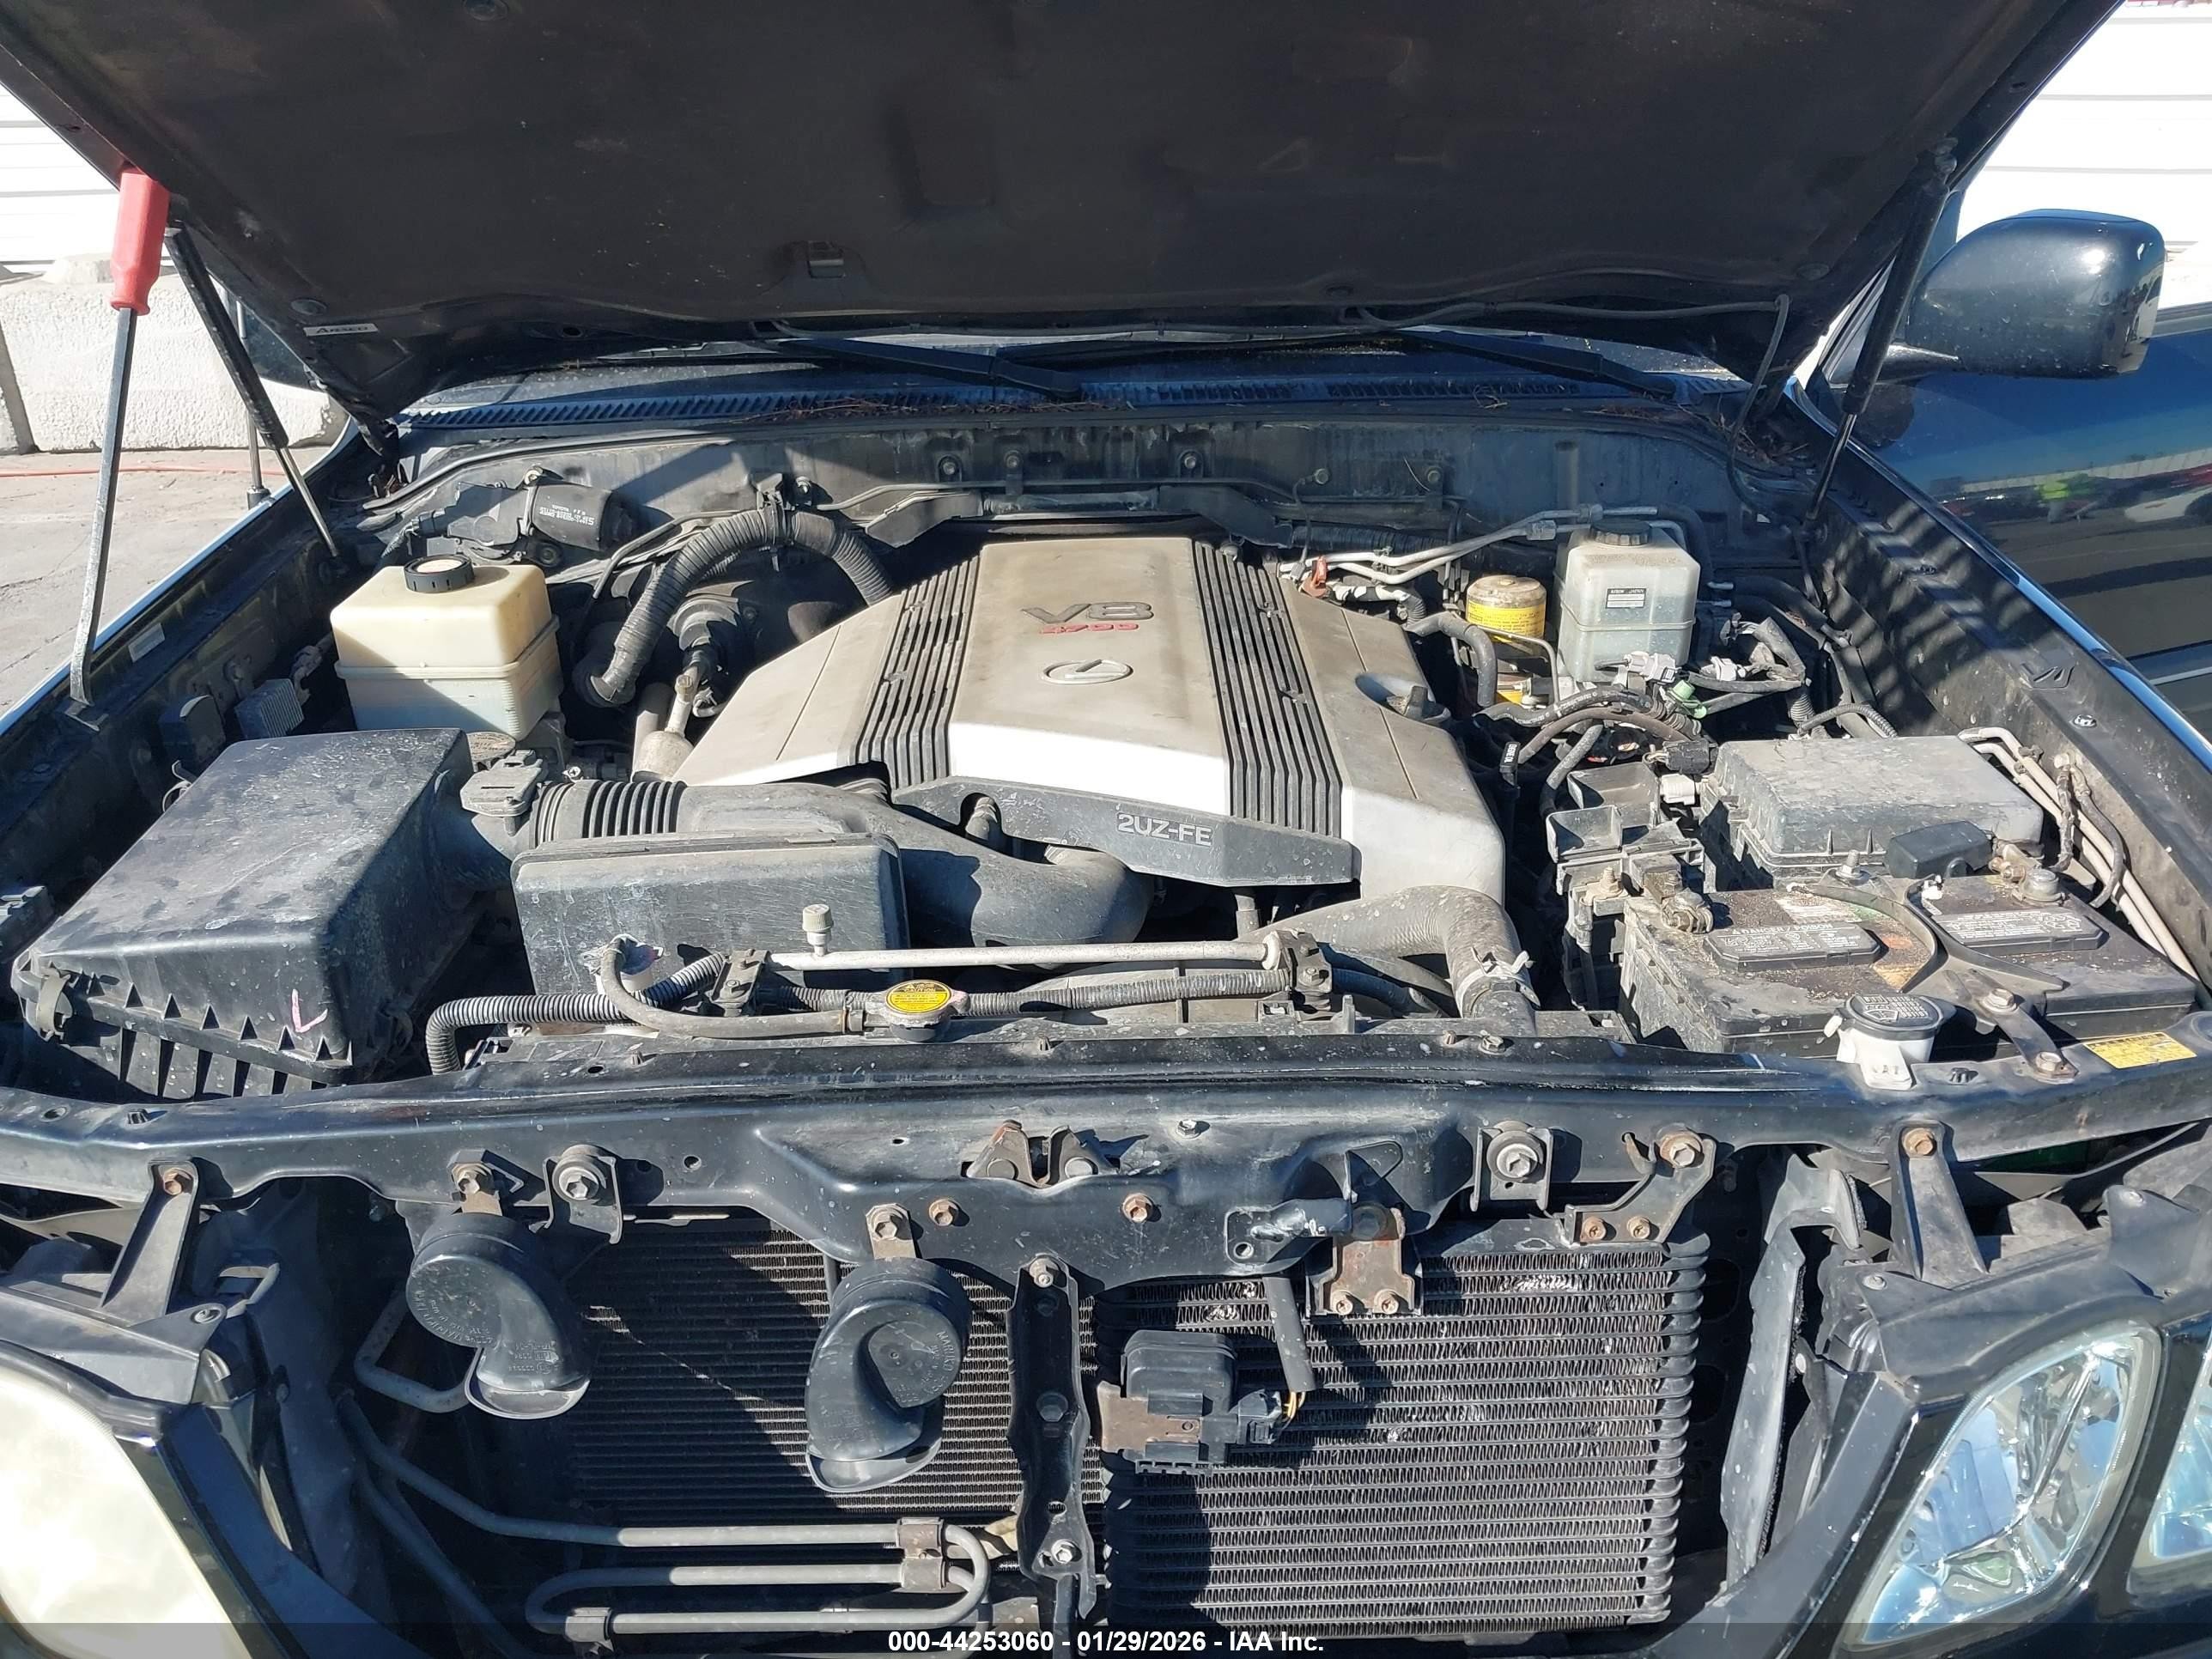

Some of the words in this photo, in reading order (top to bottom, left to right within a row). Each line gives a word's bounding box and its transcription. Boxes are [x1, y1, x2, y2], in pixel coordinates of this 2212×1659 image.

[1020, 601, 1155, 624] V8
[1117, 812, 1212, 847] 2UZ-FE
[1742, 927, 1784, 935] DANGER
